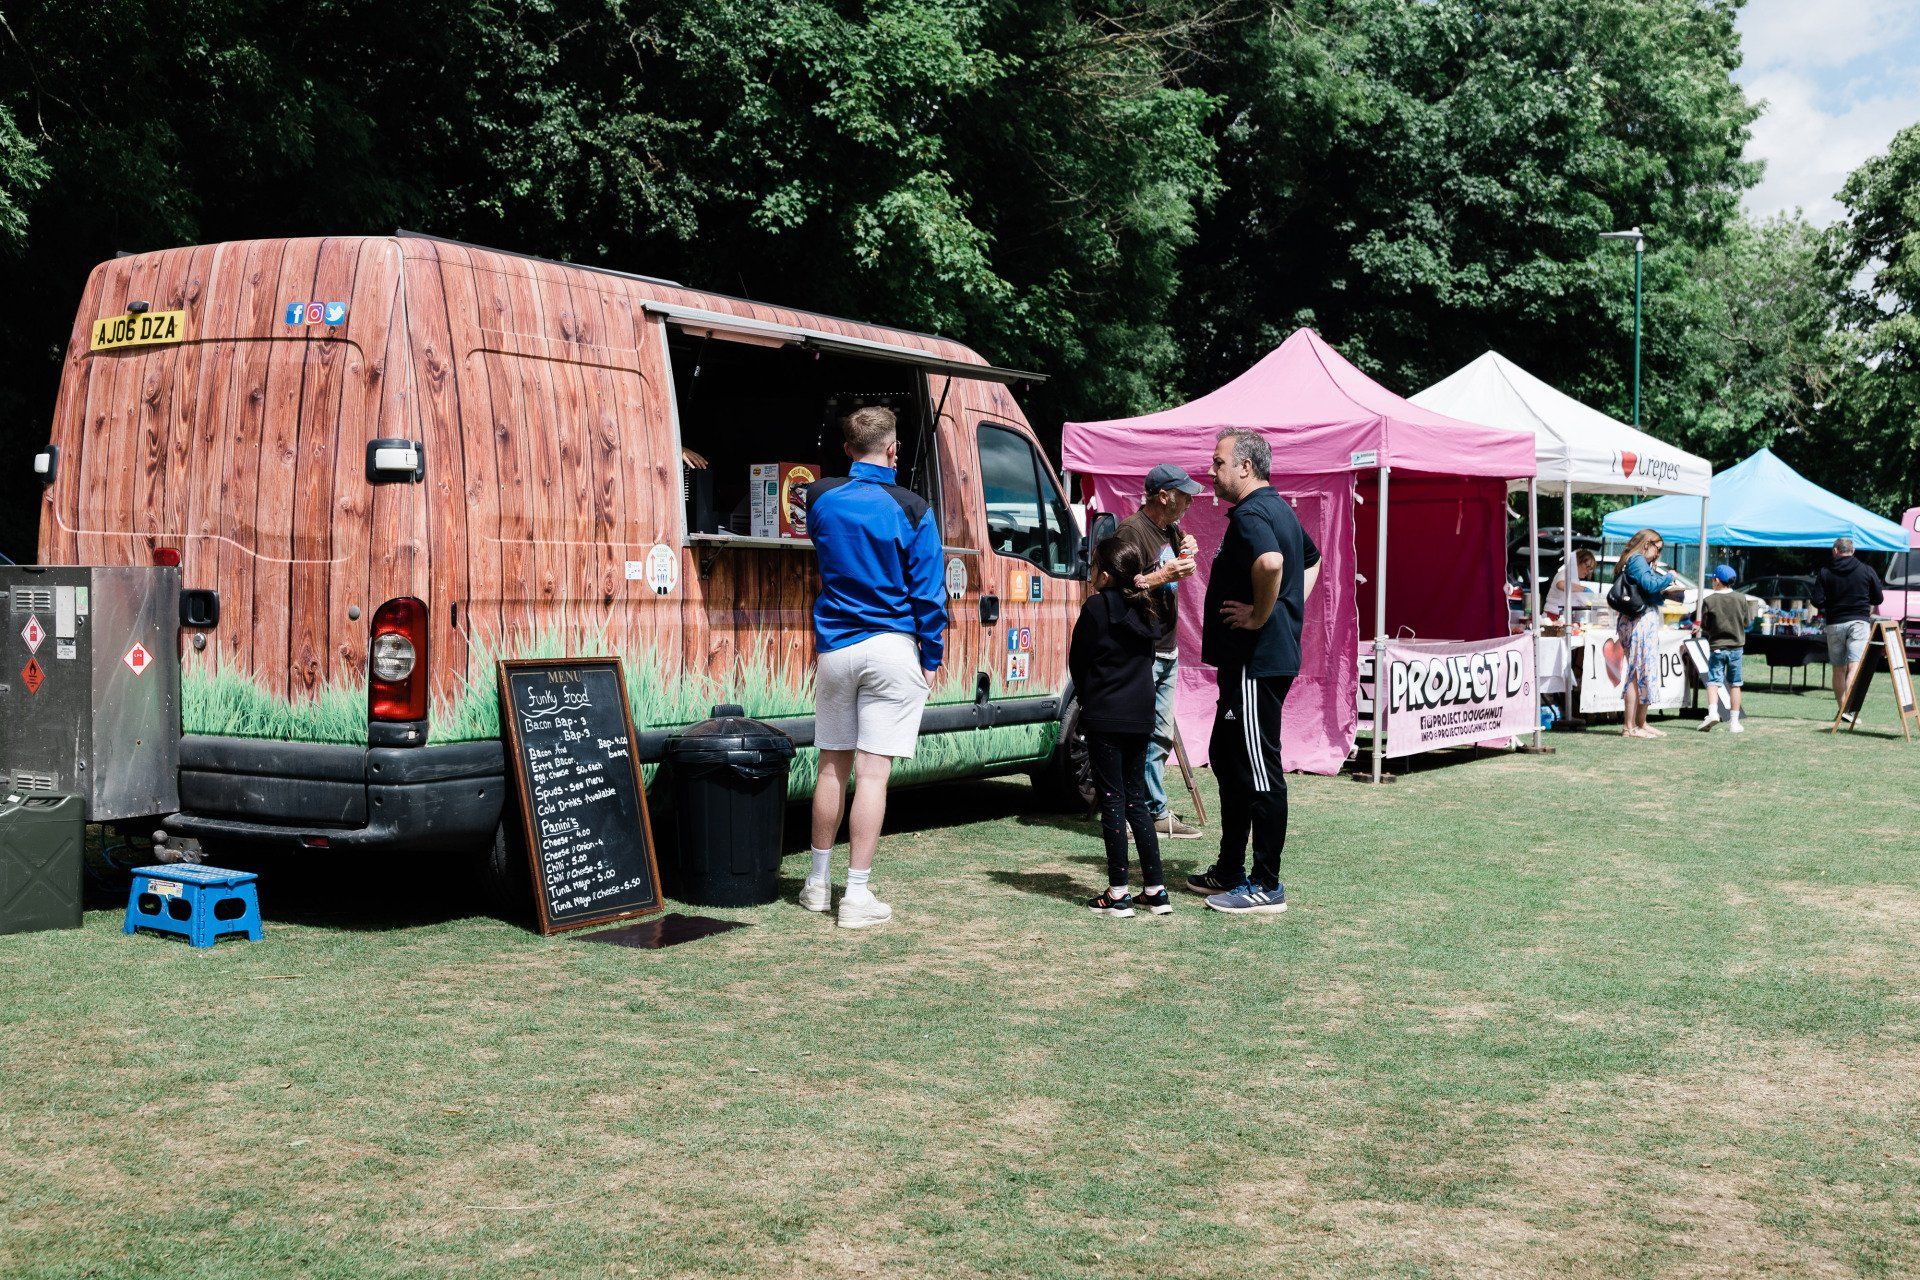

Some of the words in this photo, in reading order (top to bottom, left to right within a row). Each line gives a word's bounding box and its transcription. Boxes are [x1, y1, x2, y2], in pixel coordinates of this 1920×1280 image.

[98, 318, 137, 345] AJ06
[140, 315, 176, 340] DZA
[548, 670, 582, 684] MENU
[1390, 652, 1501, 714] PROJECT
[1506, 650, 1523, 698] D
[525, 718, 552, 732] Bacon
[528, 748, 552, 760] Bacon
[532, 762, 553, 773] Extra
[535, 786, 564, 803] Spuds
[538, 804, 556, 817] Cold
[559, 798, 583, 812] Drinks
[584, 787, 616, 804] Available
[541, 817, 580, 836] Panini's
[544, 848, 570, 862] Cheese
[546, 860, 565, 874] Chilli
[547, 872, 565, 884] Chilli
[549, 884, 572, 899] Tuna
[573, 878, 591, 891] Mayo
[551, 900, 573, 914] Tuna
[574, 896, 592, 909] Mayo
